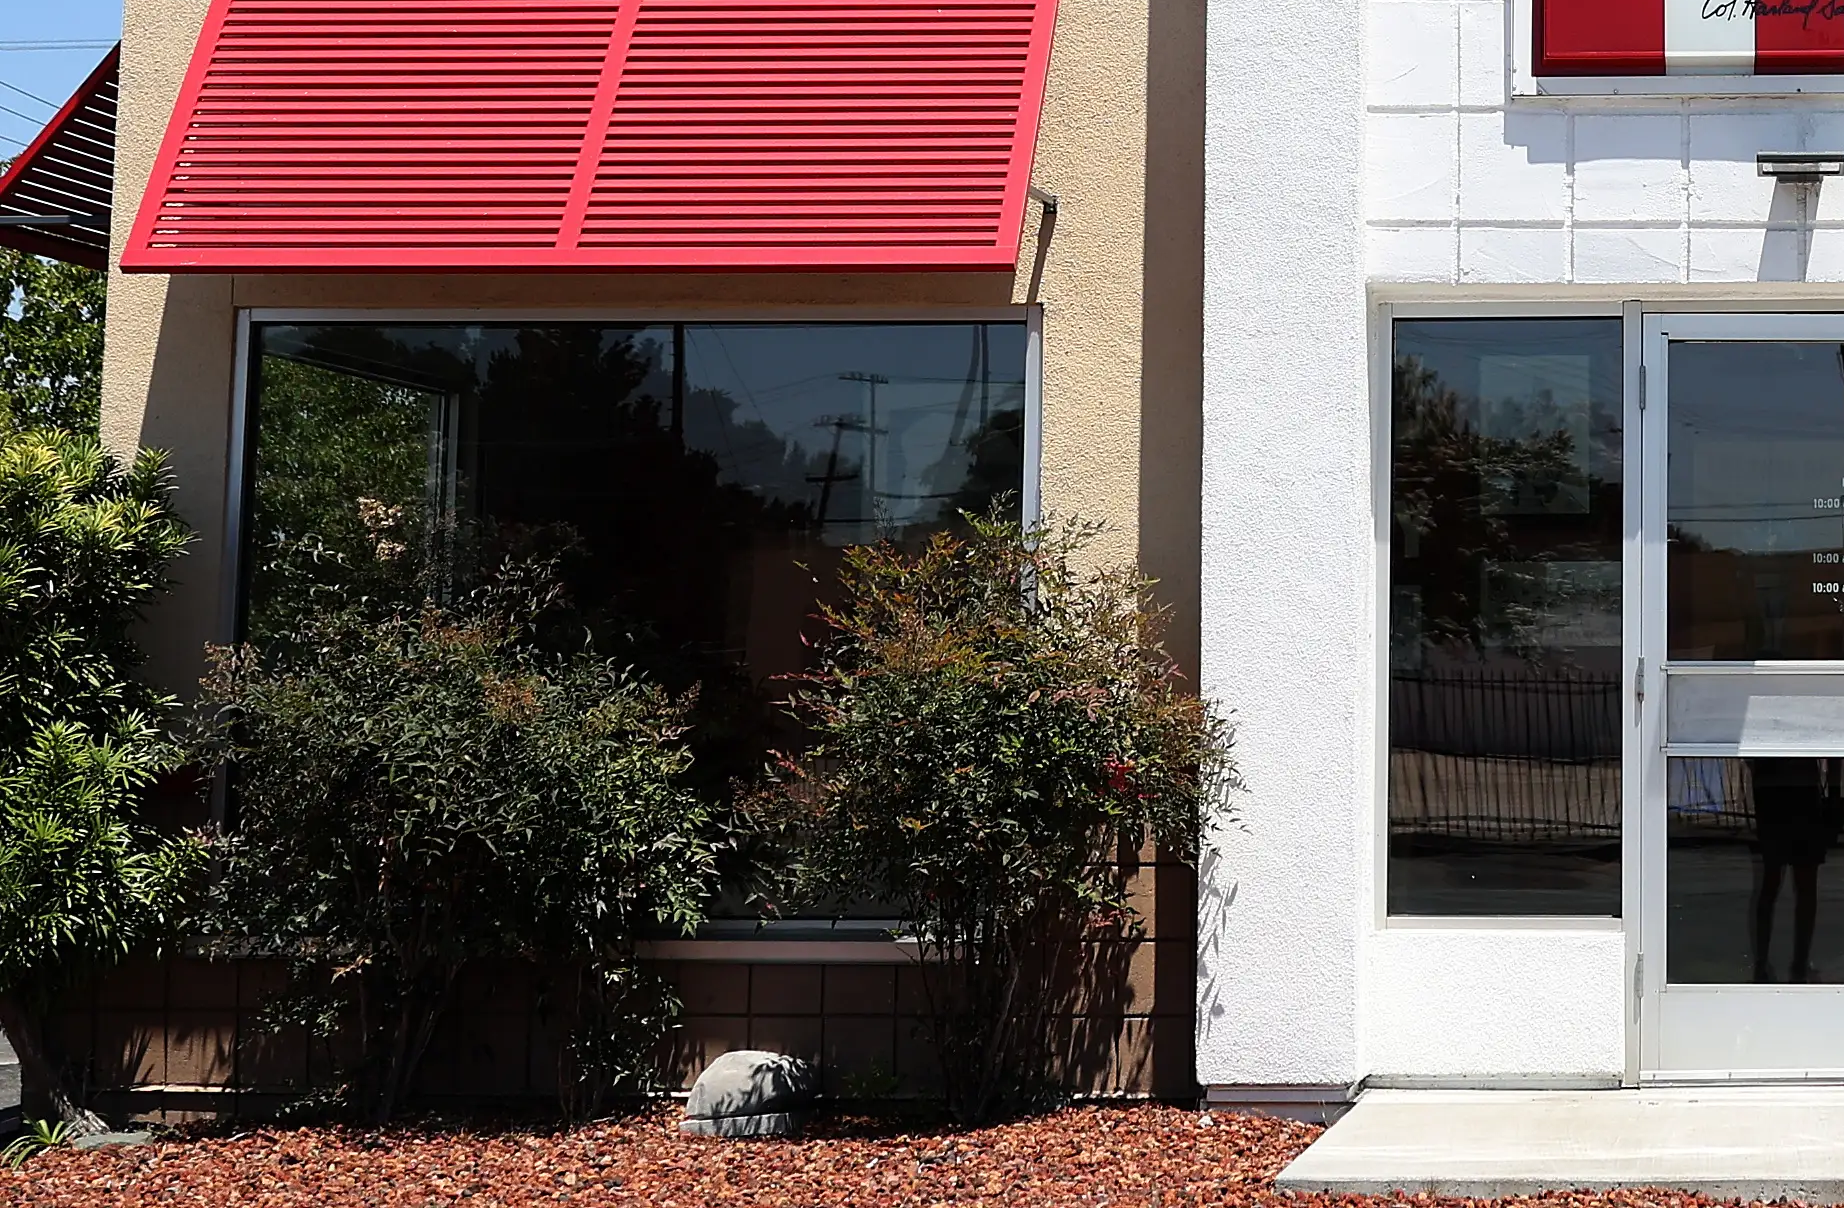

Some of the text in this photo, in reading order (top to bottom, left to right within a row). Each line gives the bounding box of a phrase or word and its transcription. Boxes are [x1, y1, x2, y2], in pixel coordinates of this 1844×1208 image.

[1813, 498, 1840, 509] 10:00
[1812, 553, 1839, 564] 10:00
[1812, 582, 1839, 593] 10:00
